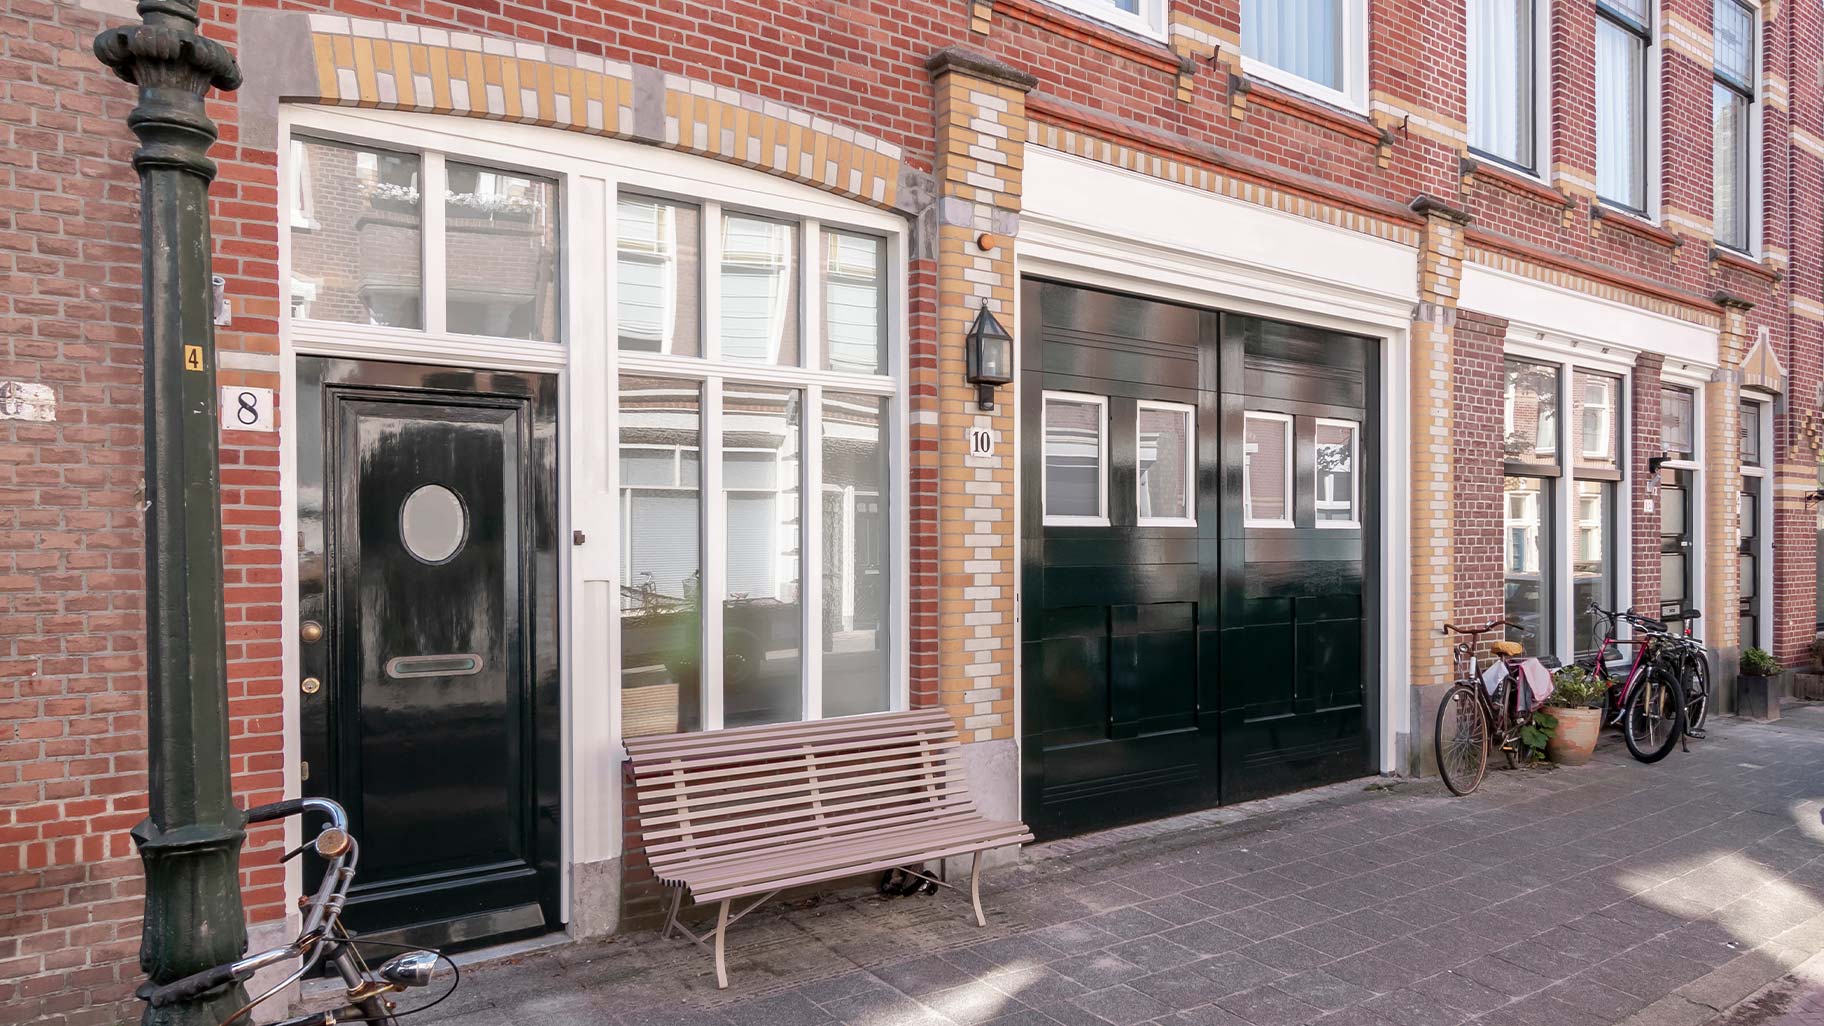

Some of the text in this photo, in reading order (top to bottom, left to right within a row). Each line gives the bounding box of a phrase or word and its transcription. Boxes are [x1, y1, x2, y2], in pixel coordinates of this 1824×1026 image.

[188, 348, 199, 369] 4
[237, 391, 258, 425] 8
[972, 431, 991, 453] 10
